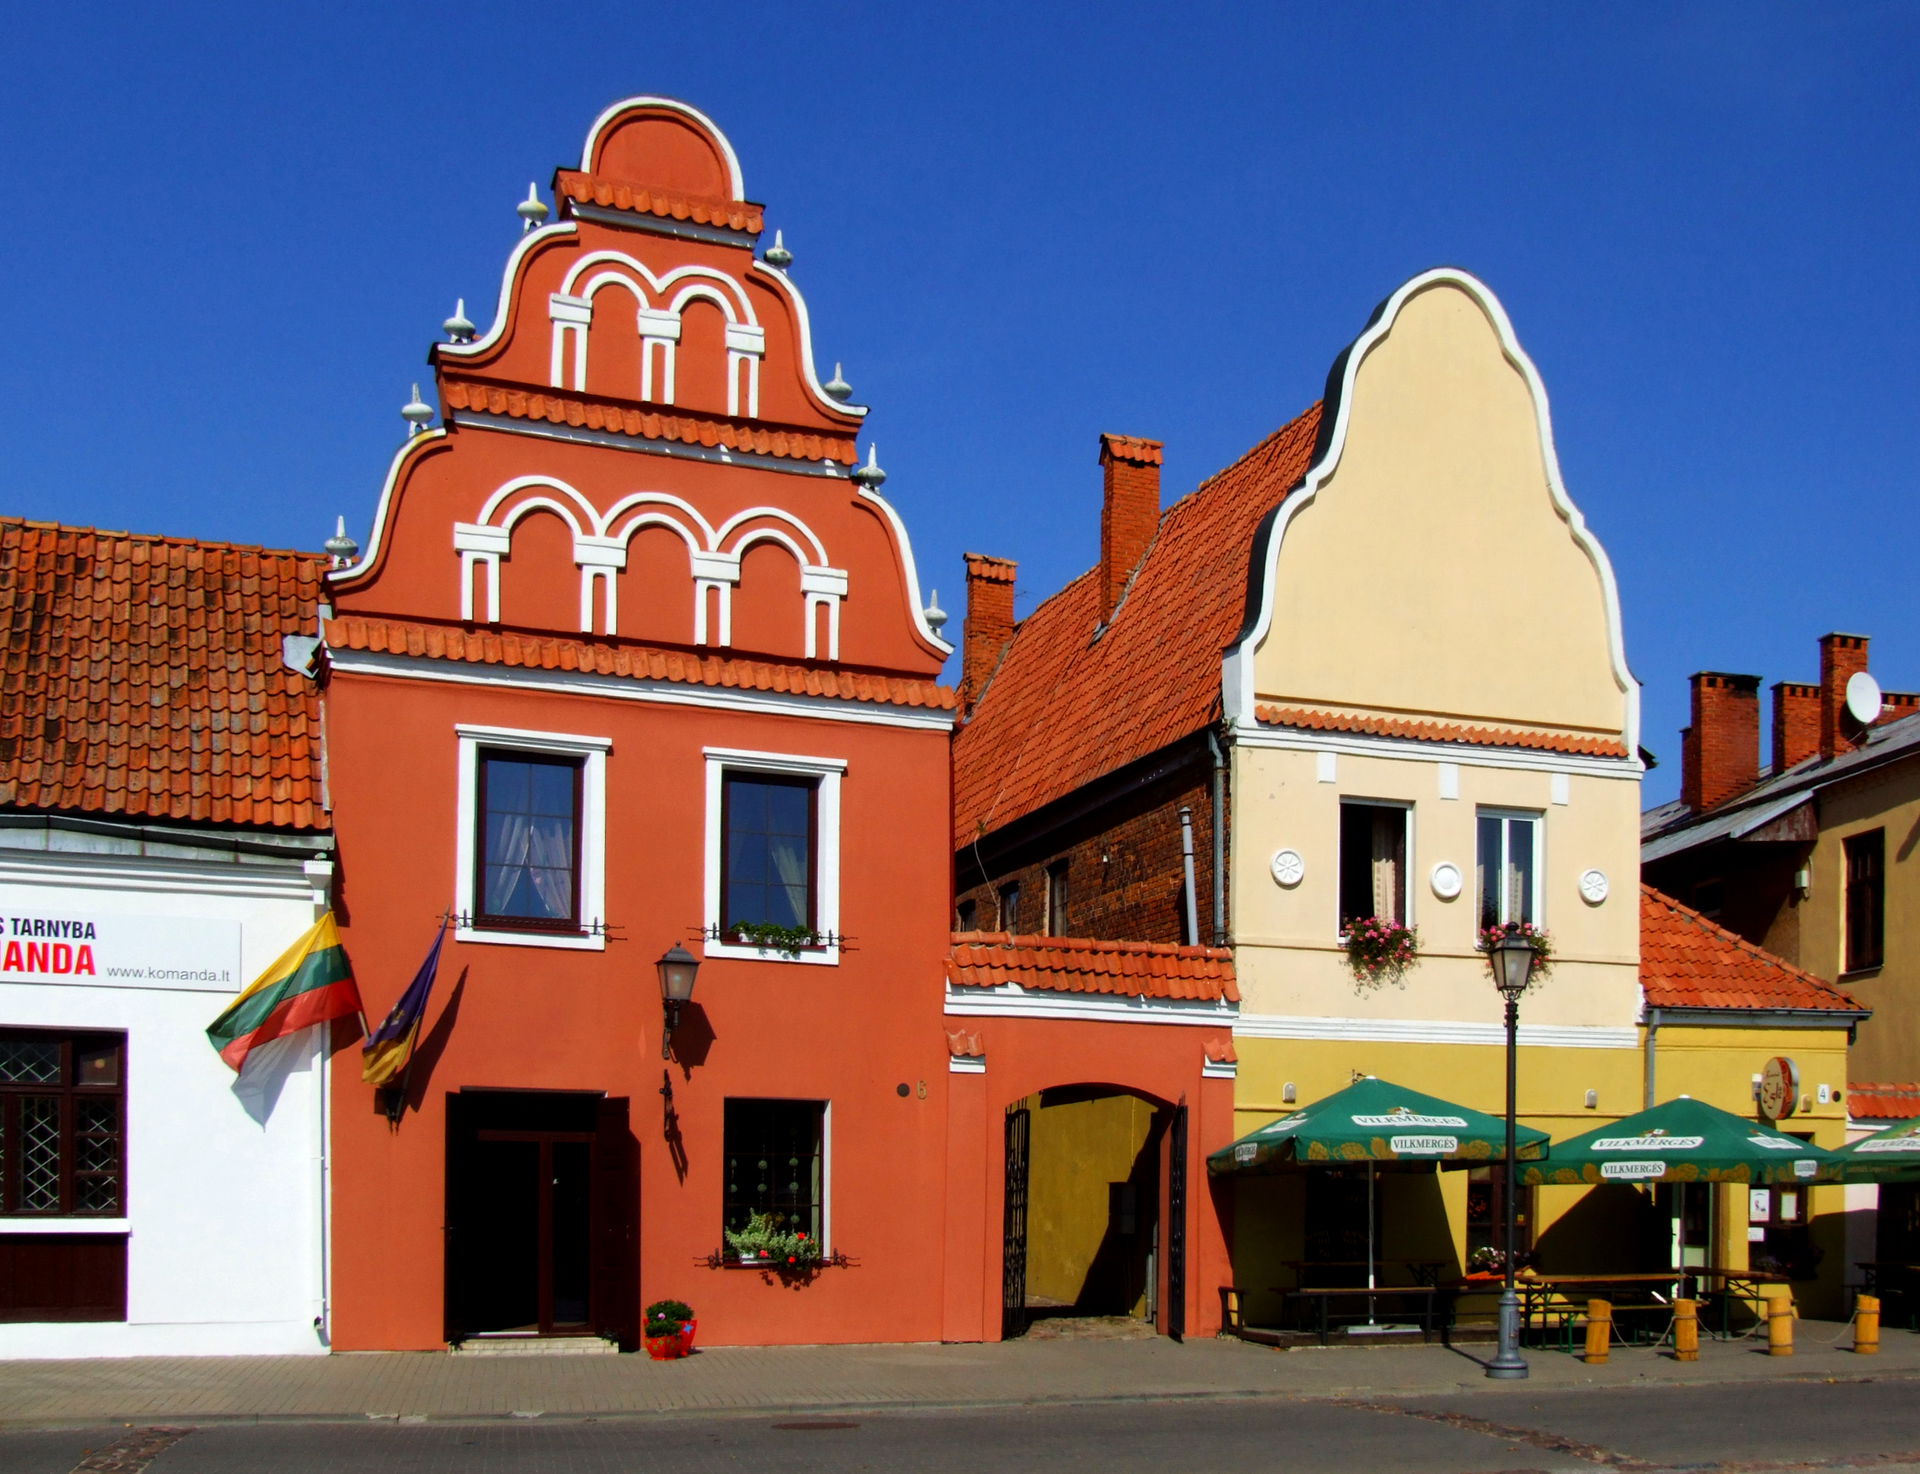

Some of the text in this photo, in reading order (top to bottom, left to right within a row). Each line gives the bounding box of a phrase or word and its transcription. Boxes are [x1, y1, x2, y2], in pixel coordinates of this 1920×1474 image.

[11, 918, 96, 940] TARNYBA
[0, 941, 96, 976] ANDA
[107, 967, 230, 982] www.komanda.lt
[917, 1080, 927, 1100] 6
